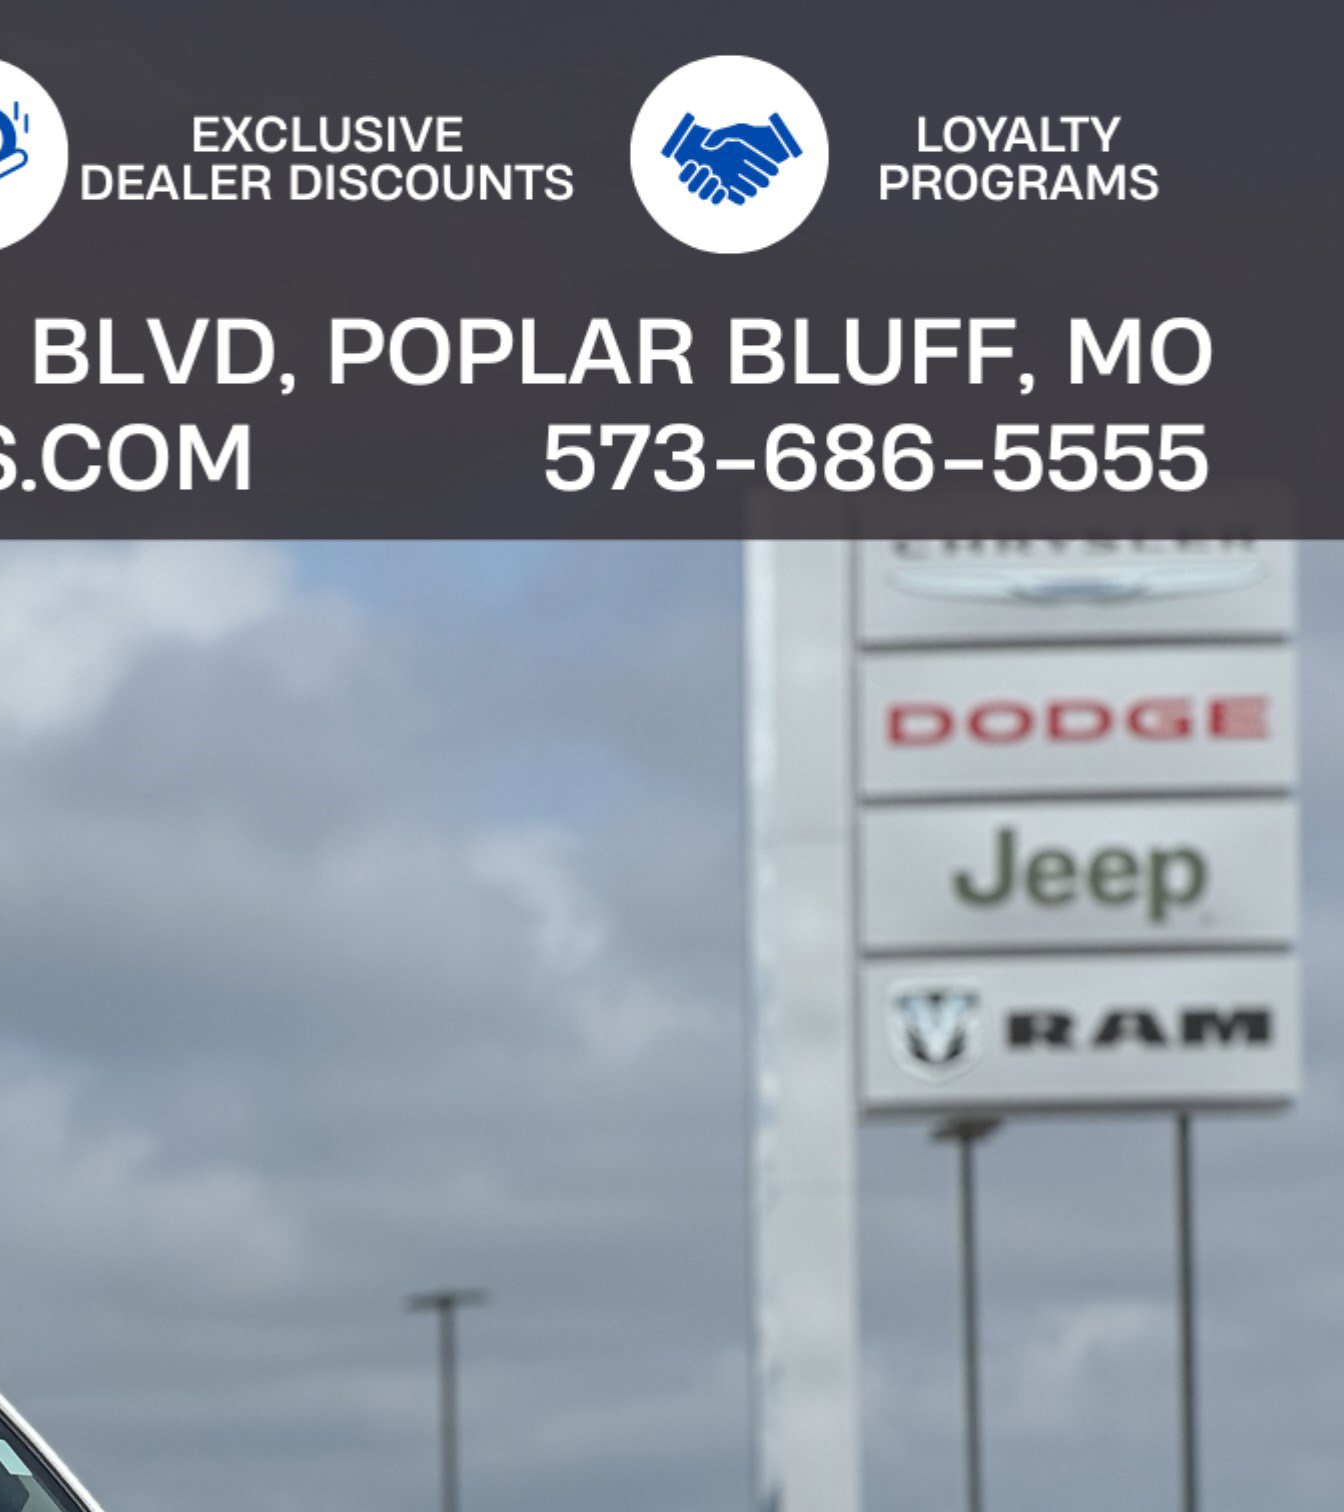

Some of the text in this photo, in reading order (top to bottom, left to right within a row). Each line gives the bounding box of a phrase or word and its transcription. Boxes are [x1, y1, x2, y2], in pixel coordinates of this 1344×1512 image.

[885, 696, 1271, 746] DODGE
[952, 825, 1207, 925] Jeep
[1005, 1008, 1273, 1049] RAM
